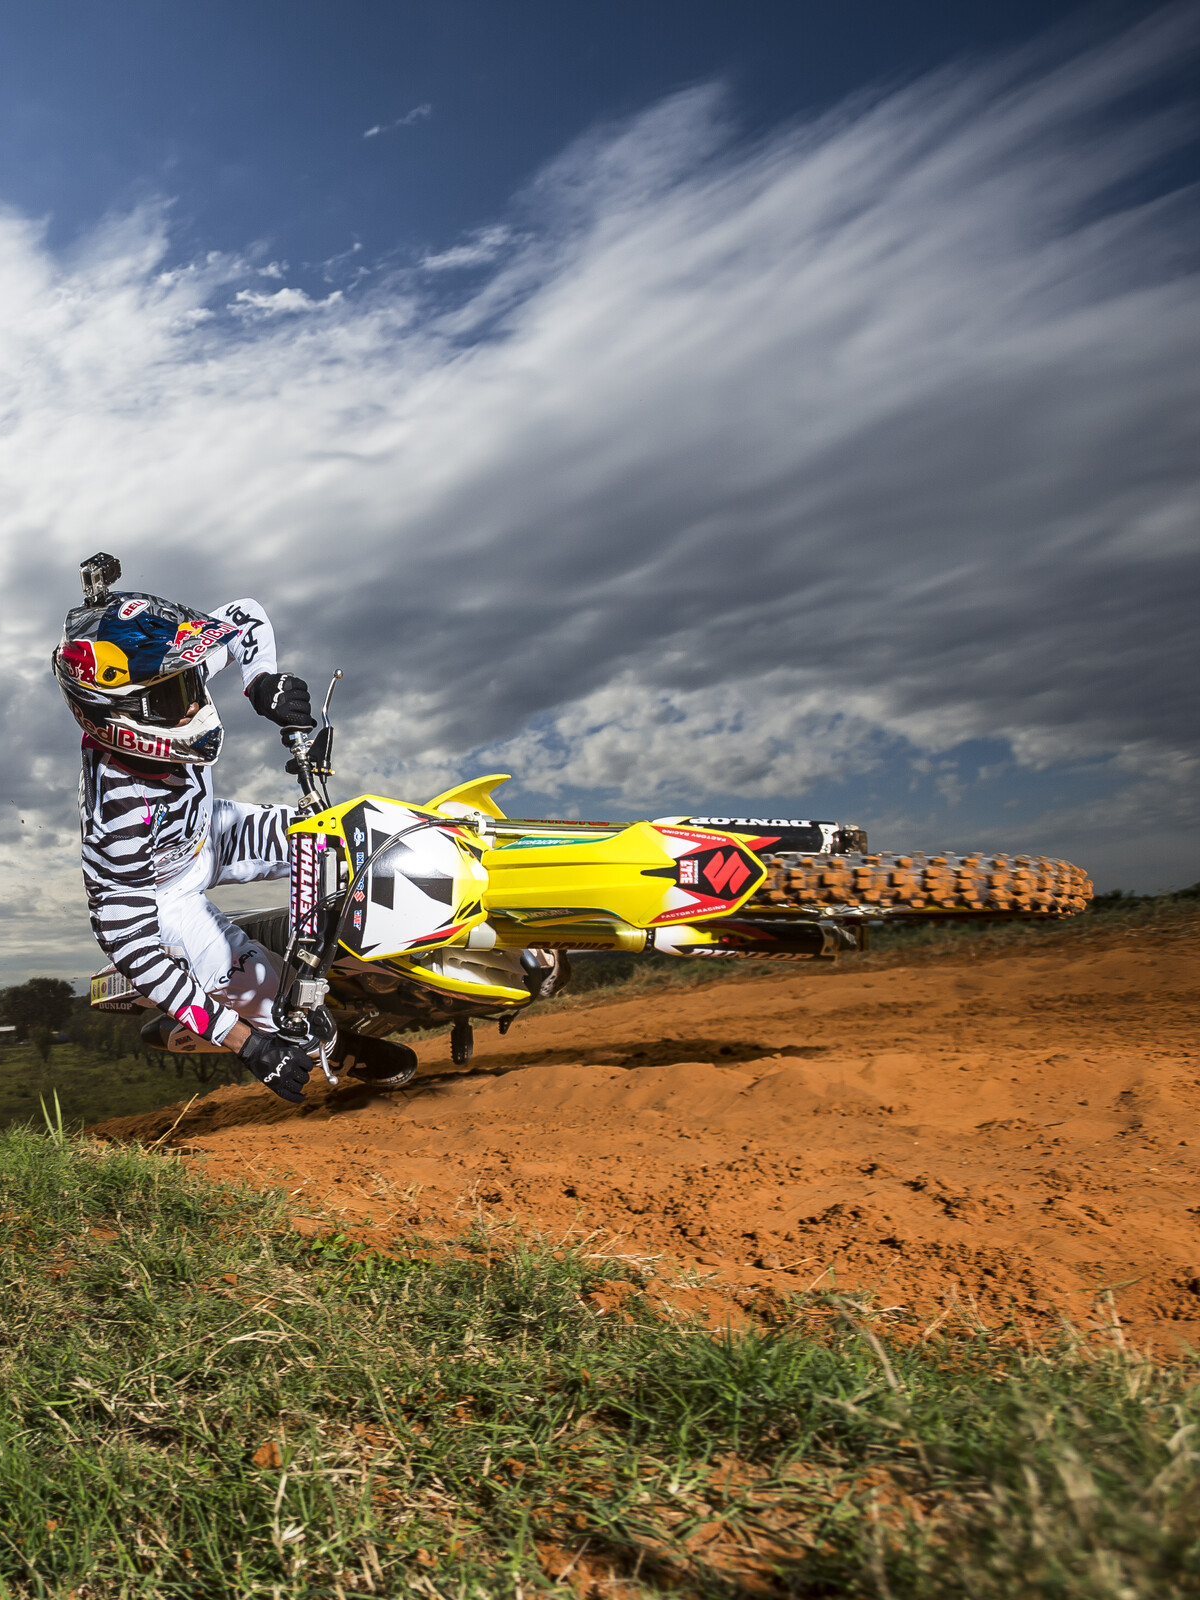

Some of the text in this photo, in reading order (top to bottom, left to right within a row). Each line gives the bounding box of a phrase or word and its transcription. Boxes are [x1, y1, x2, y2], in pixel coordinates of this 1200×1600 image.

[122, 600, 146, 617] BELL
[181, 622, 237, 663] Red Bull
[71, 700, 115, 744] Red
[118, 728, 171, 757] Bull
[689, 816, 812, 828] DUNLOP
[661, 829, 727, 842] FACTORY RACING
[661, 904, 727, 919] FACTORY RACING
[99, 1002, 133, 1011] DUNLOP
